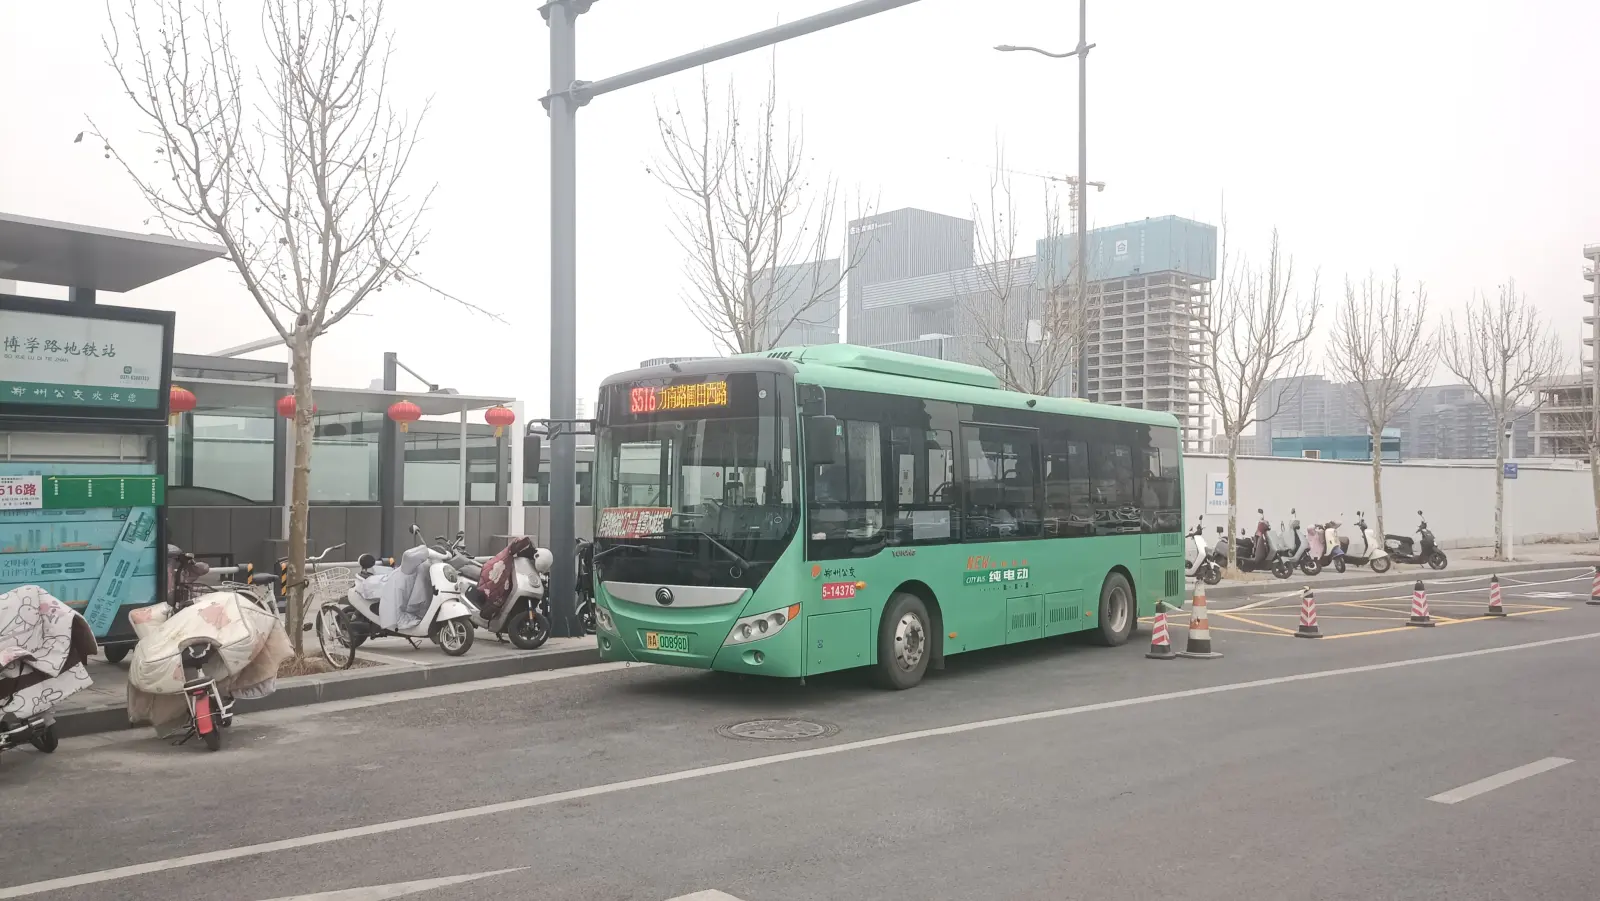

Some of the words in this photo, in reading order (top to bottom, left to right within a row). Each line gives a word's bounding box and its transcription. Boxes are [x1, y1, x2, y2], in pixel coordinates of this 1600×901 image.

[3, 335, 117, 358] 博学路地铁站
[11, 386, 137, 403] 郑州公交欢迎您
[631, 387, 656, 413] S516
[967, 555, 991, 570] NEW
[823, 567, 856, 579] 郑州公交
[988, 567, 1029, 583] 纯电动
[822, 584, 855, 598] 5-14376
